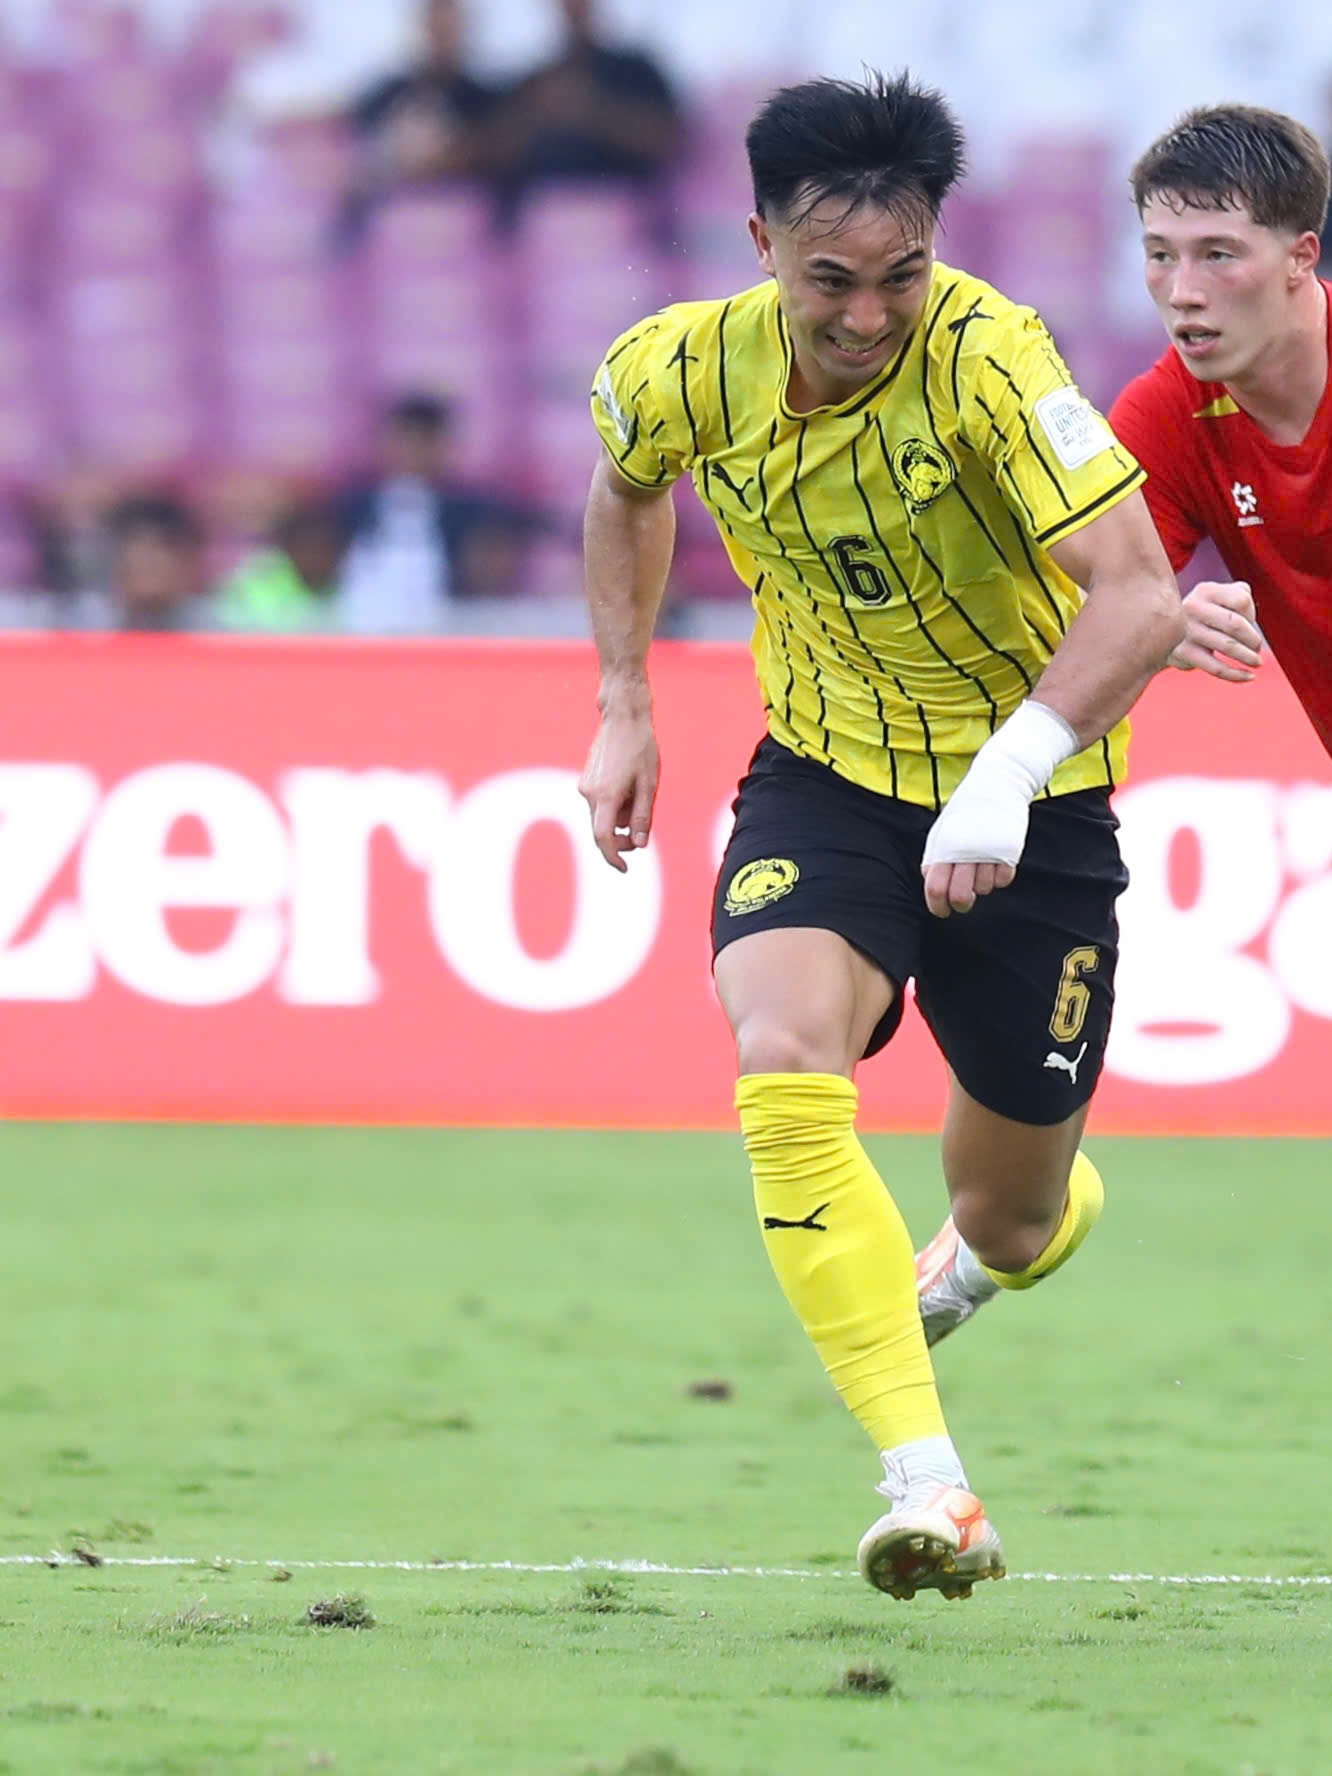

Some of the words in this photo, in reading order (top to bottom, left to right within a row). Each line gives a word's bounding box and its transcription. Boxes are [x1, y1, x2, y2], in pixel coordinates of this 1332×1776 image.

[827, 535, 892, 606] 6
[0, 762, 662, 1012] zero
[1048, 945, 1099, 1043] 6
